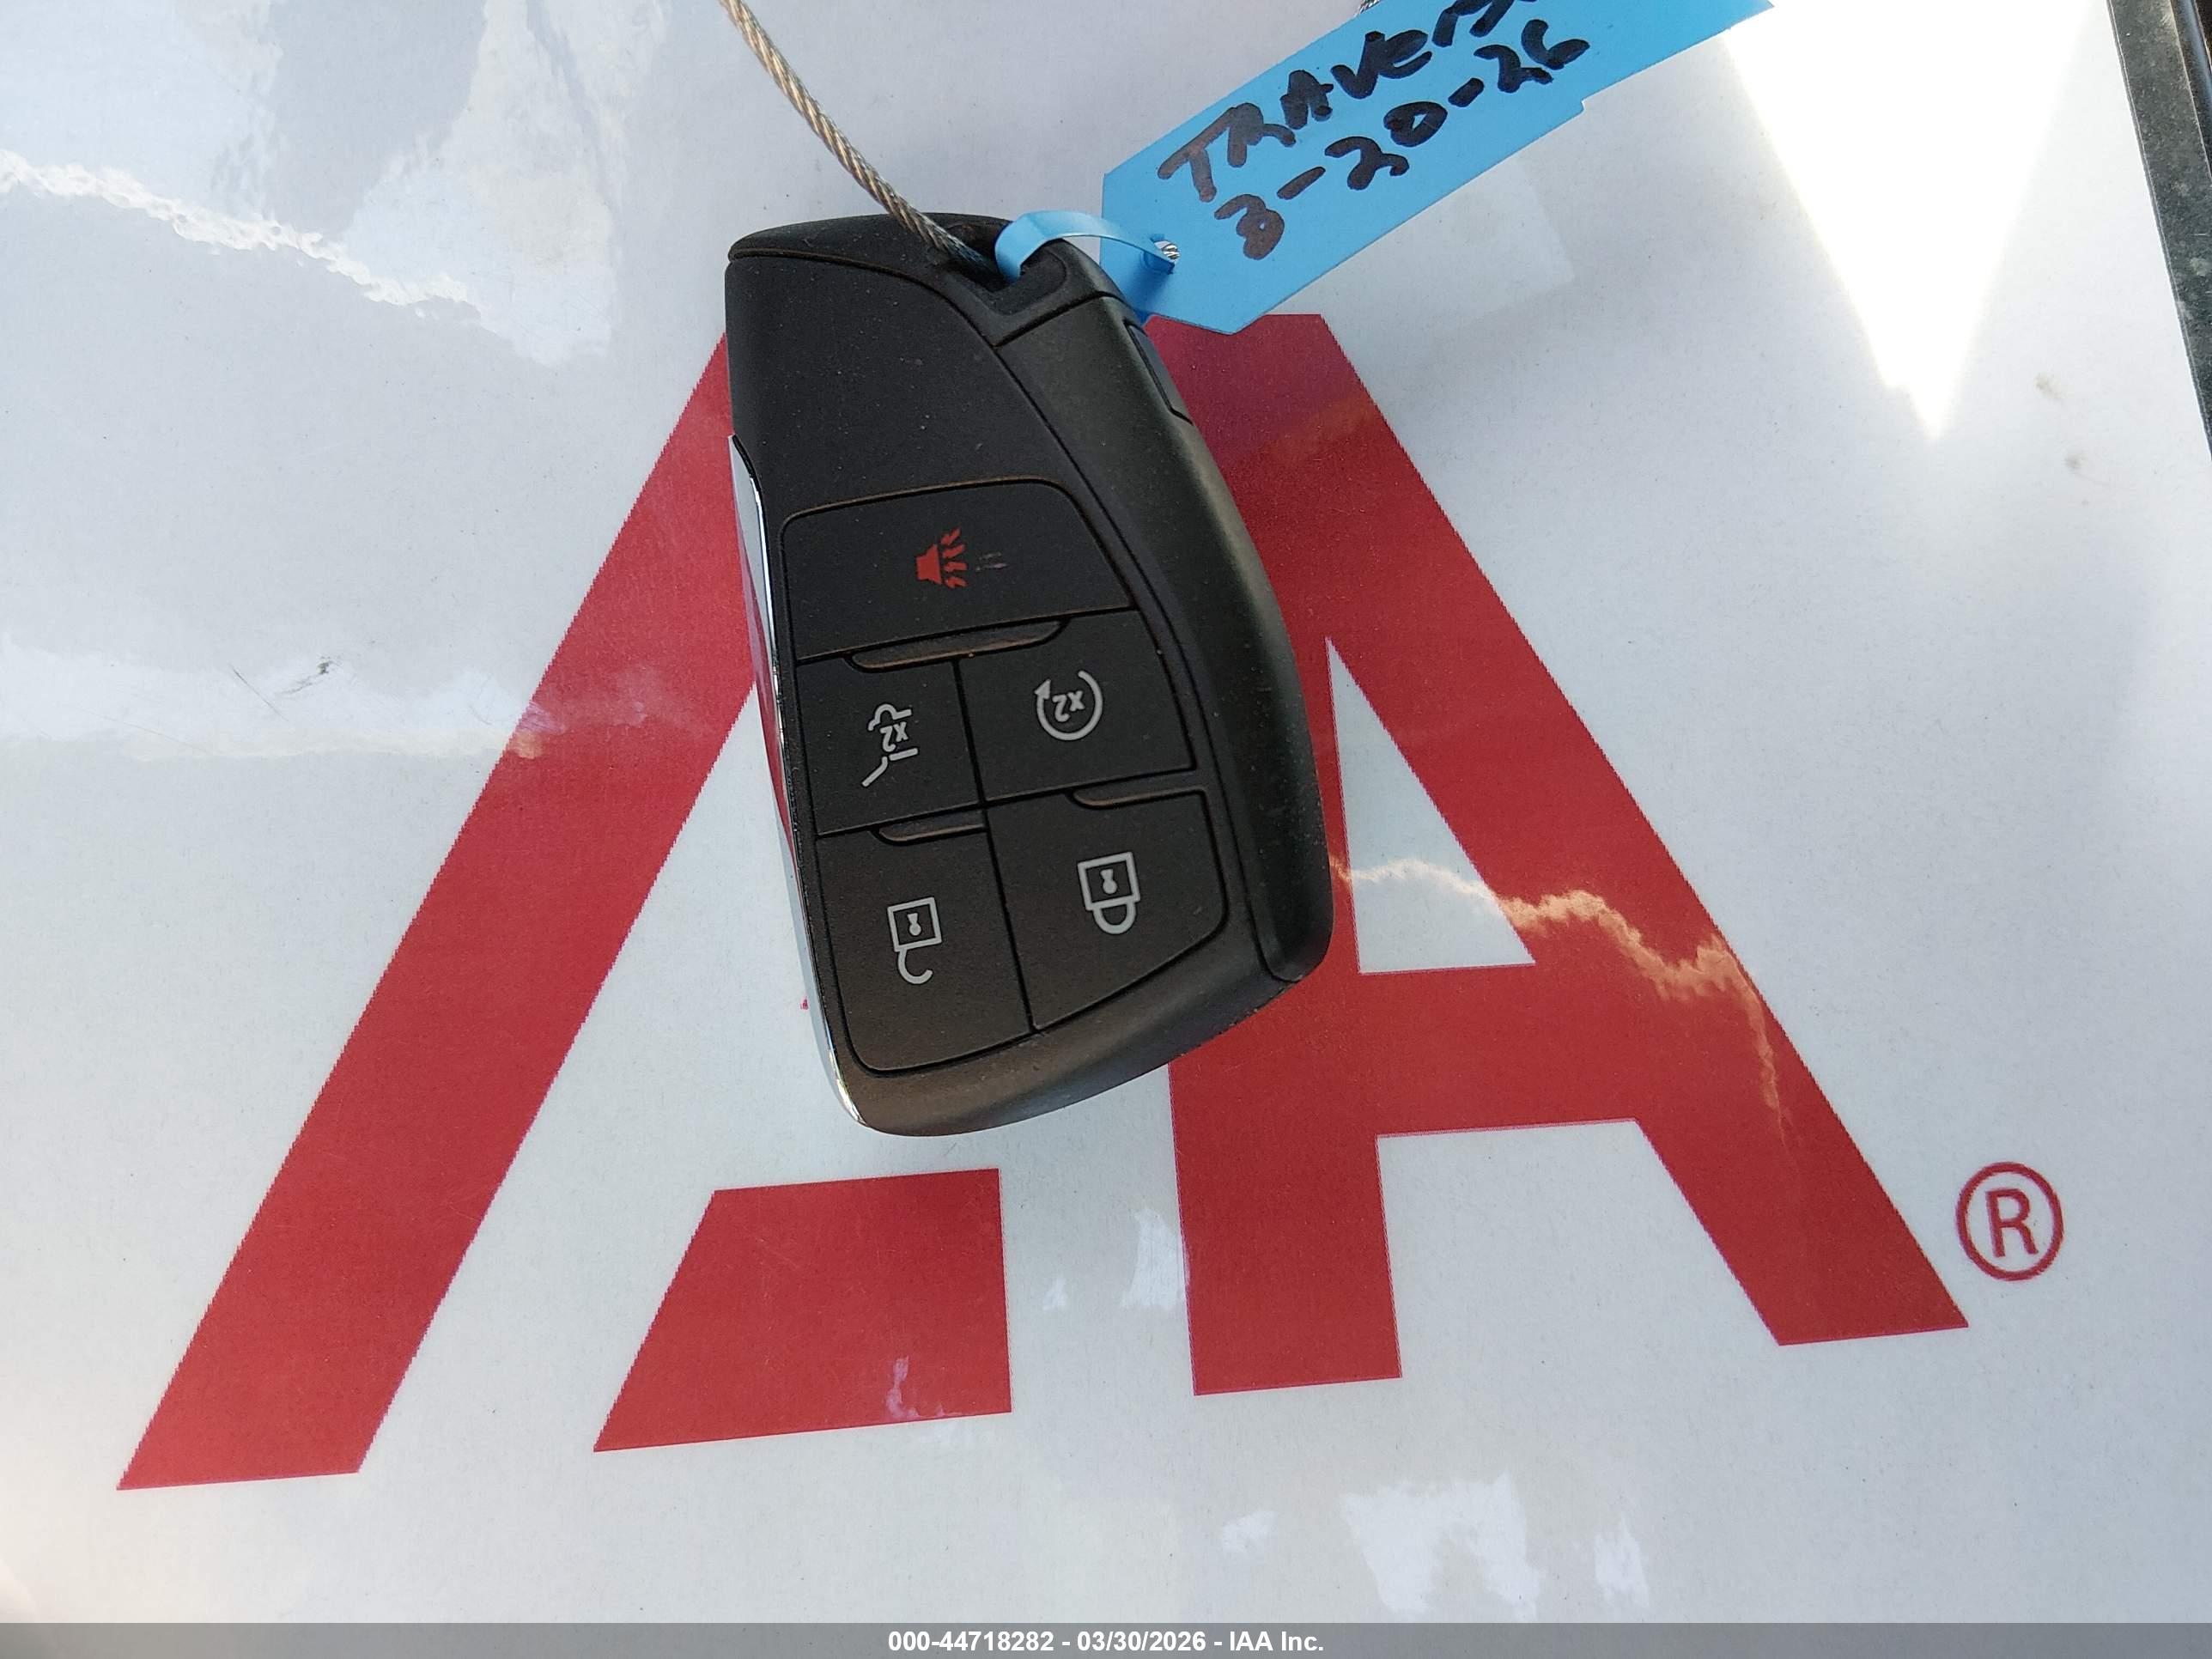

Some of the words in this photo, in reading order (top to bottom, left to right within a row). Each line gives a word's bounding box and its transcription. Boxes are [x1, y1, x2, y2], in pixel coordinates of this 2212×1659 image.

[1214, 19, 1591, 259] 3-20-26
[1053, 690, 1085, 722] x2
[879, 722, 908, 752] x2
